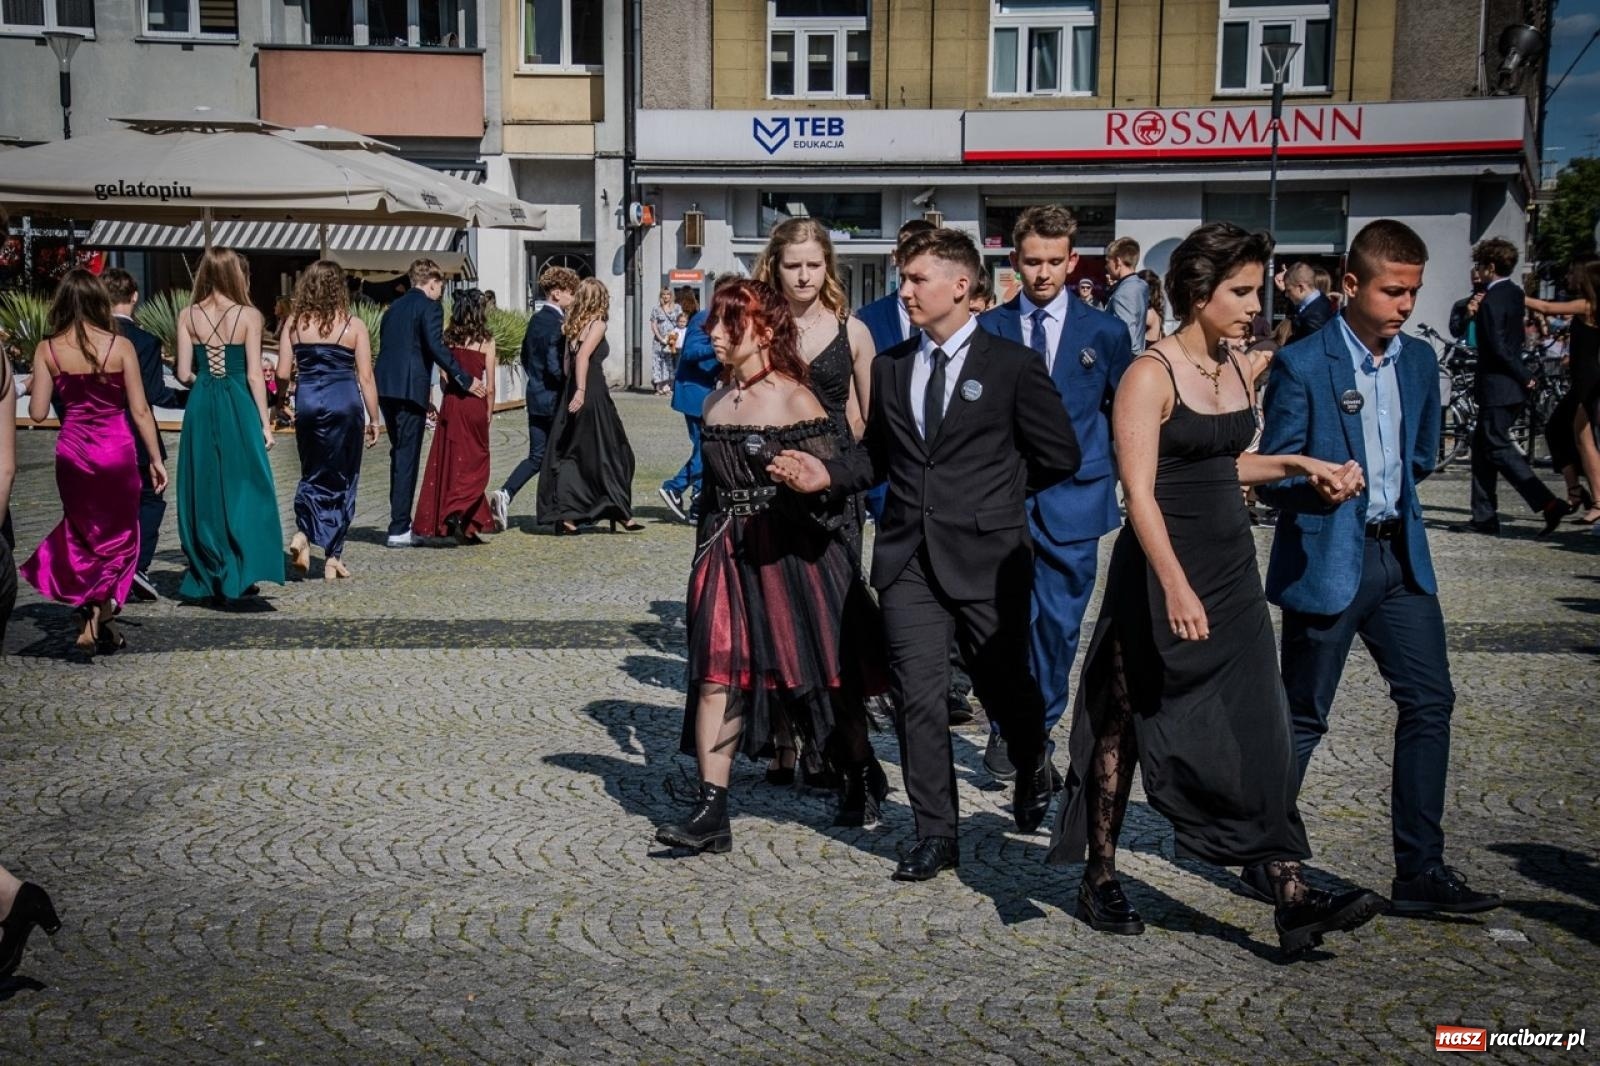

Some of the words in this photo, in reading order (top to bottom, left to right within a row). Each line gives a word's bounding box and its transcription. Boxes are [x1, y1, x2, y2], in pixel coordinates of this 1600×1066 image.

[794, 117, 845, 136] TEB
[1105, 106, 1363, 146] ROSSMANN
[793, 140, 845, 149] EDUKACJA
[94, 179, 193, 202] gelatopiu
